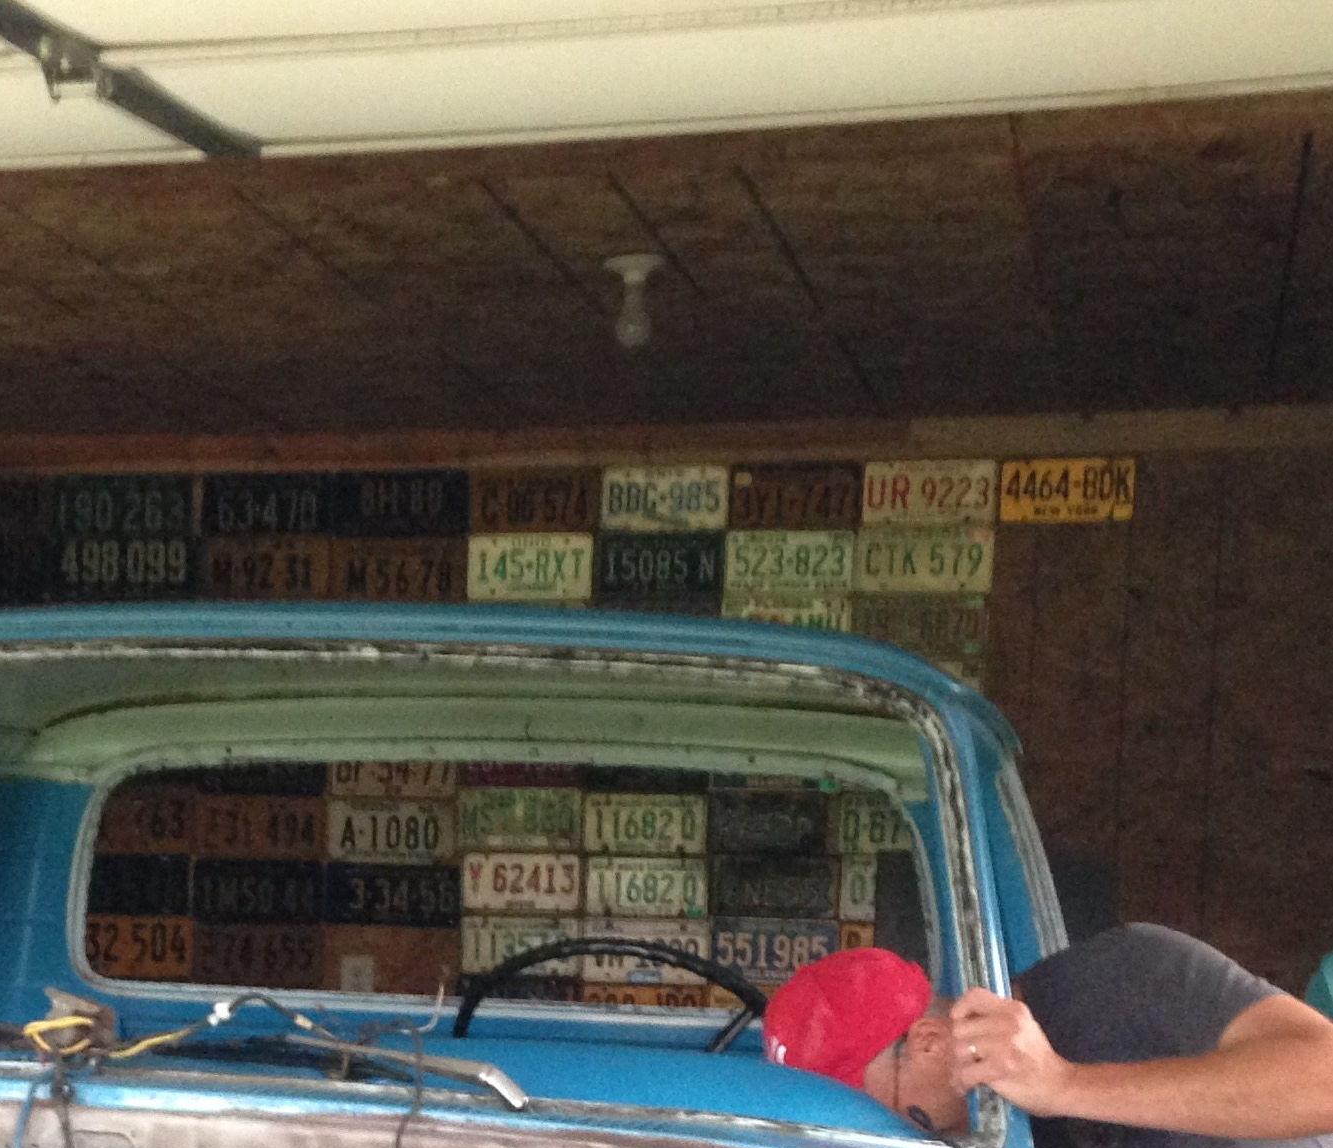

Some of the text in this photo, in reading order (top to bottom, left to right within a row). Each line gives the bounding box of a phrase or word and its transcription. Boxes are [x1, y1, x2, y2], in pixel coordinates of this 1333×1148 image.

[867, 475, 911, 511] UR
[920, 475, 991, 509] 9223
[698, 550, 716, 582] N
[928, 542, 984, 578] 579
[130, 922, 187, 963] 504
